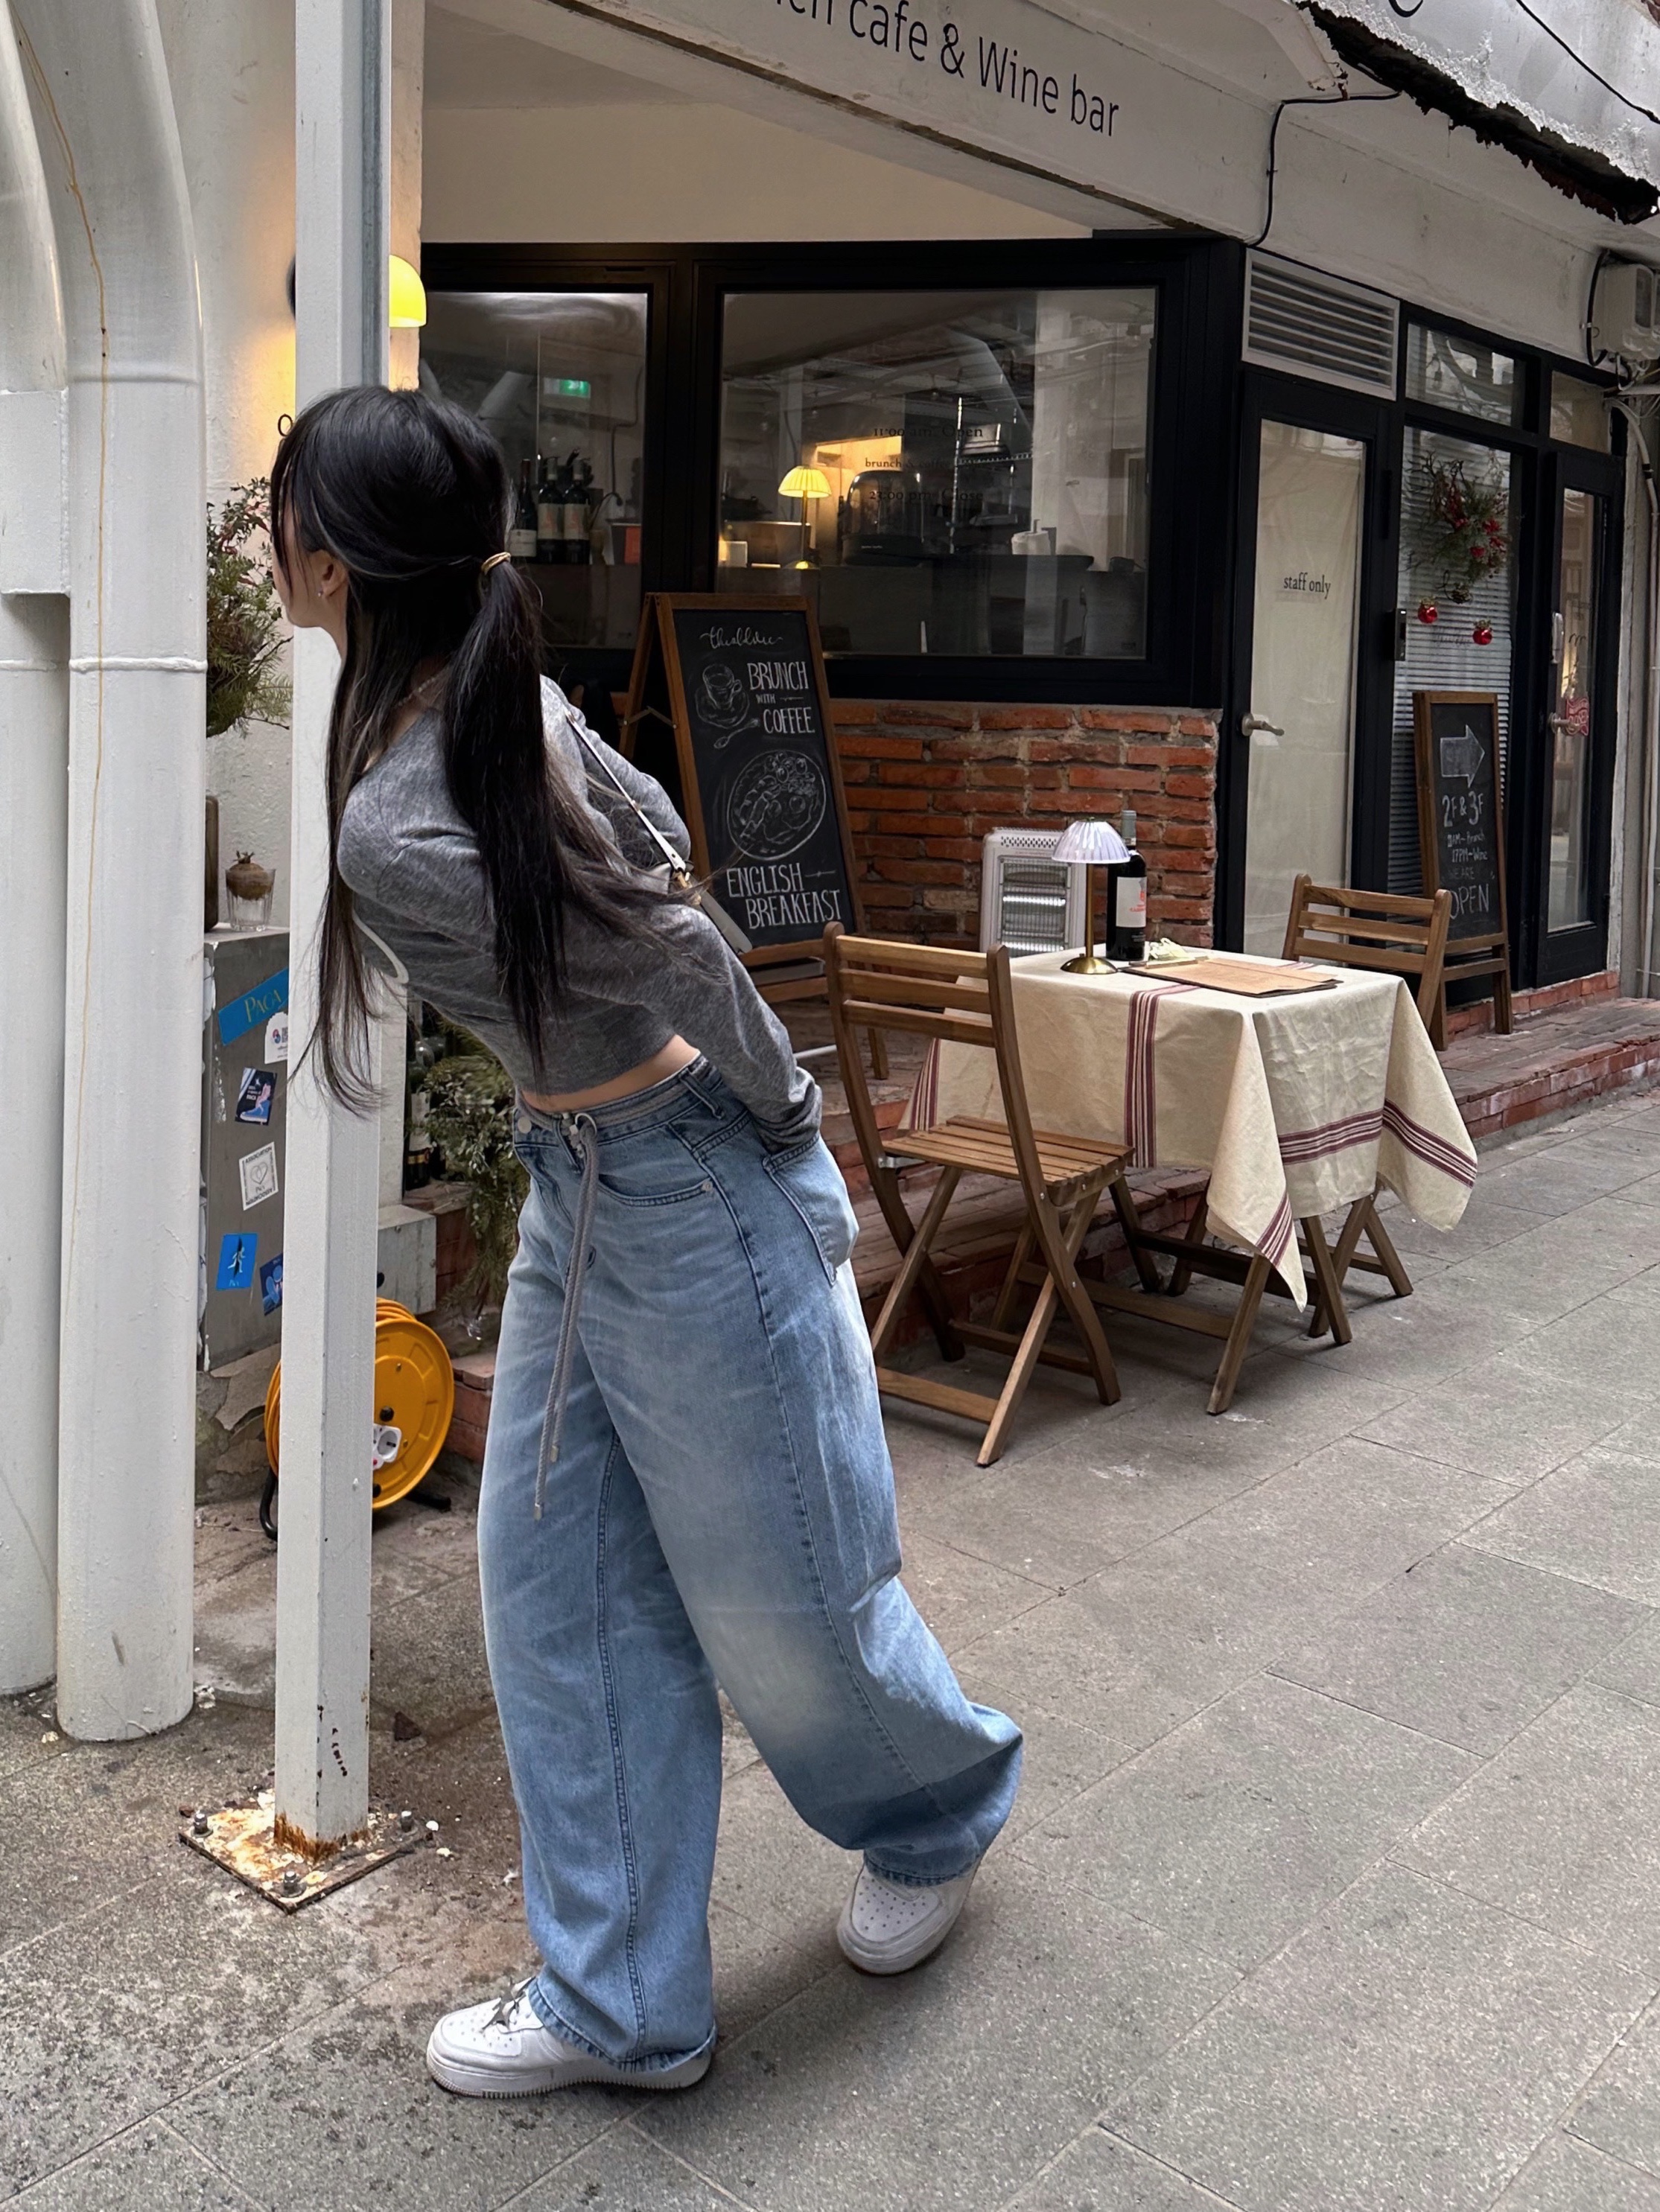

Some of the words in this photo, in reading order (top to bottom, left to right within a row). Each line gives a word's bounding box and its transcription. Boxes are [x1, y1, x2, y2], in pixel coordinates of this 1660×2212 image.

[850, 0, 927, 62] cafe
[941, 22, 964, 78] &
[979, 36, 1059, 114] Wine
[1071, 73, 1119, 137] bar
[941, 424, 984, 441] Open
[865, 457, 903, 468] brunch
[941, 488, 984, 501] Close
[1283, 571, 1308, 591] staff
[1308, 574, 1332, 600] only
[747, 660, 810, 691] BRUNCH
[756, 693, 777, 704] WITH
[763, 706, 815, 735] COFFEE
[1441, 794, 1457, 827] 2F
[1459, 795, 1468, 817] &
[1468, 791, 1484, 826] 3F
[726, 862, 804, 898] ENGLISH
[745, 889, 842, 929] BREAKFAST
